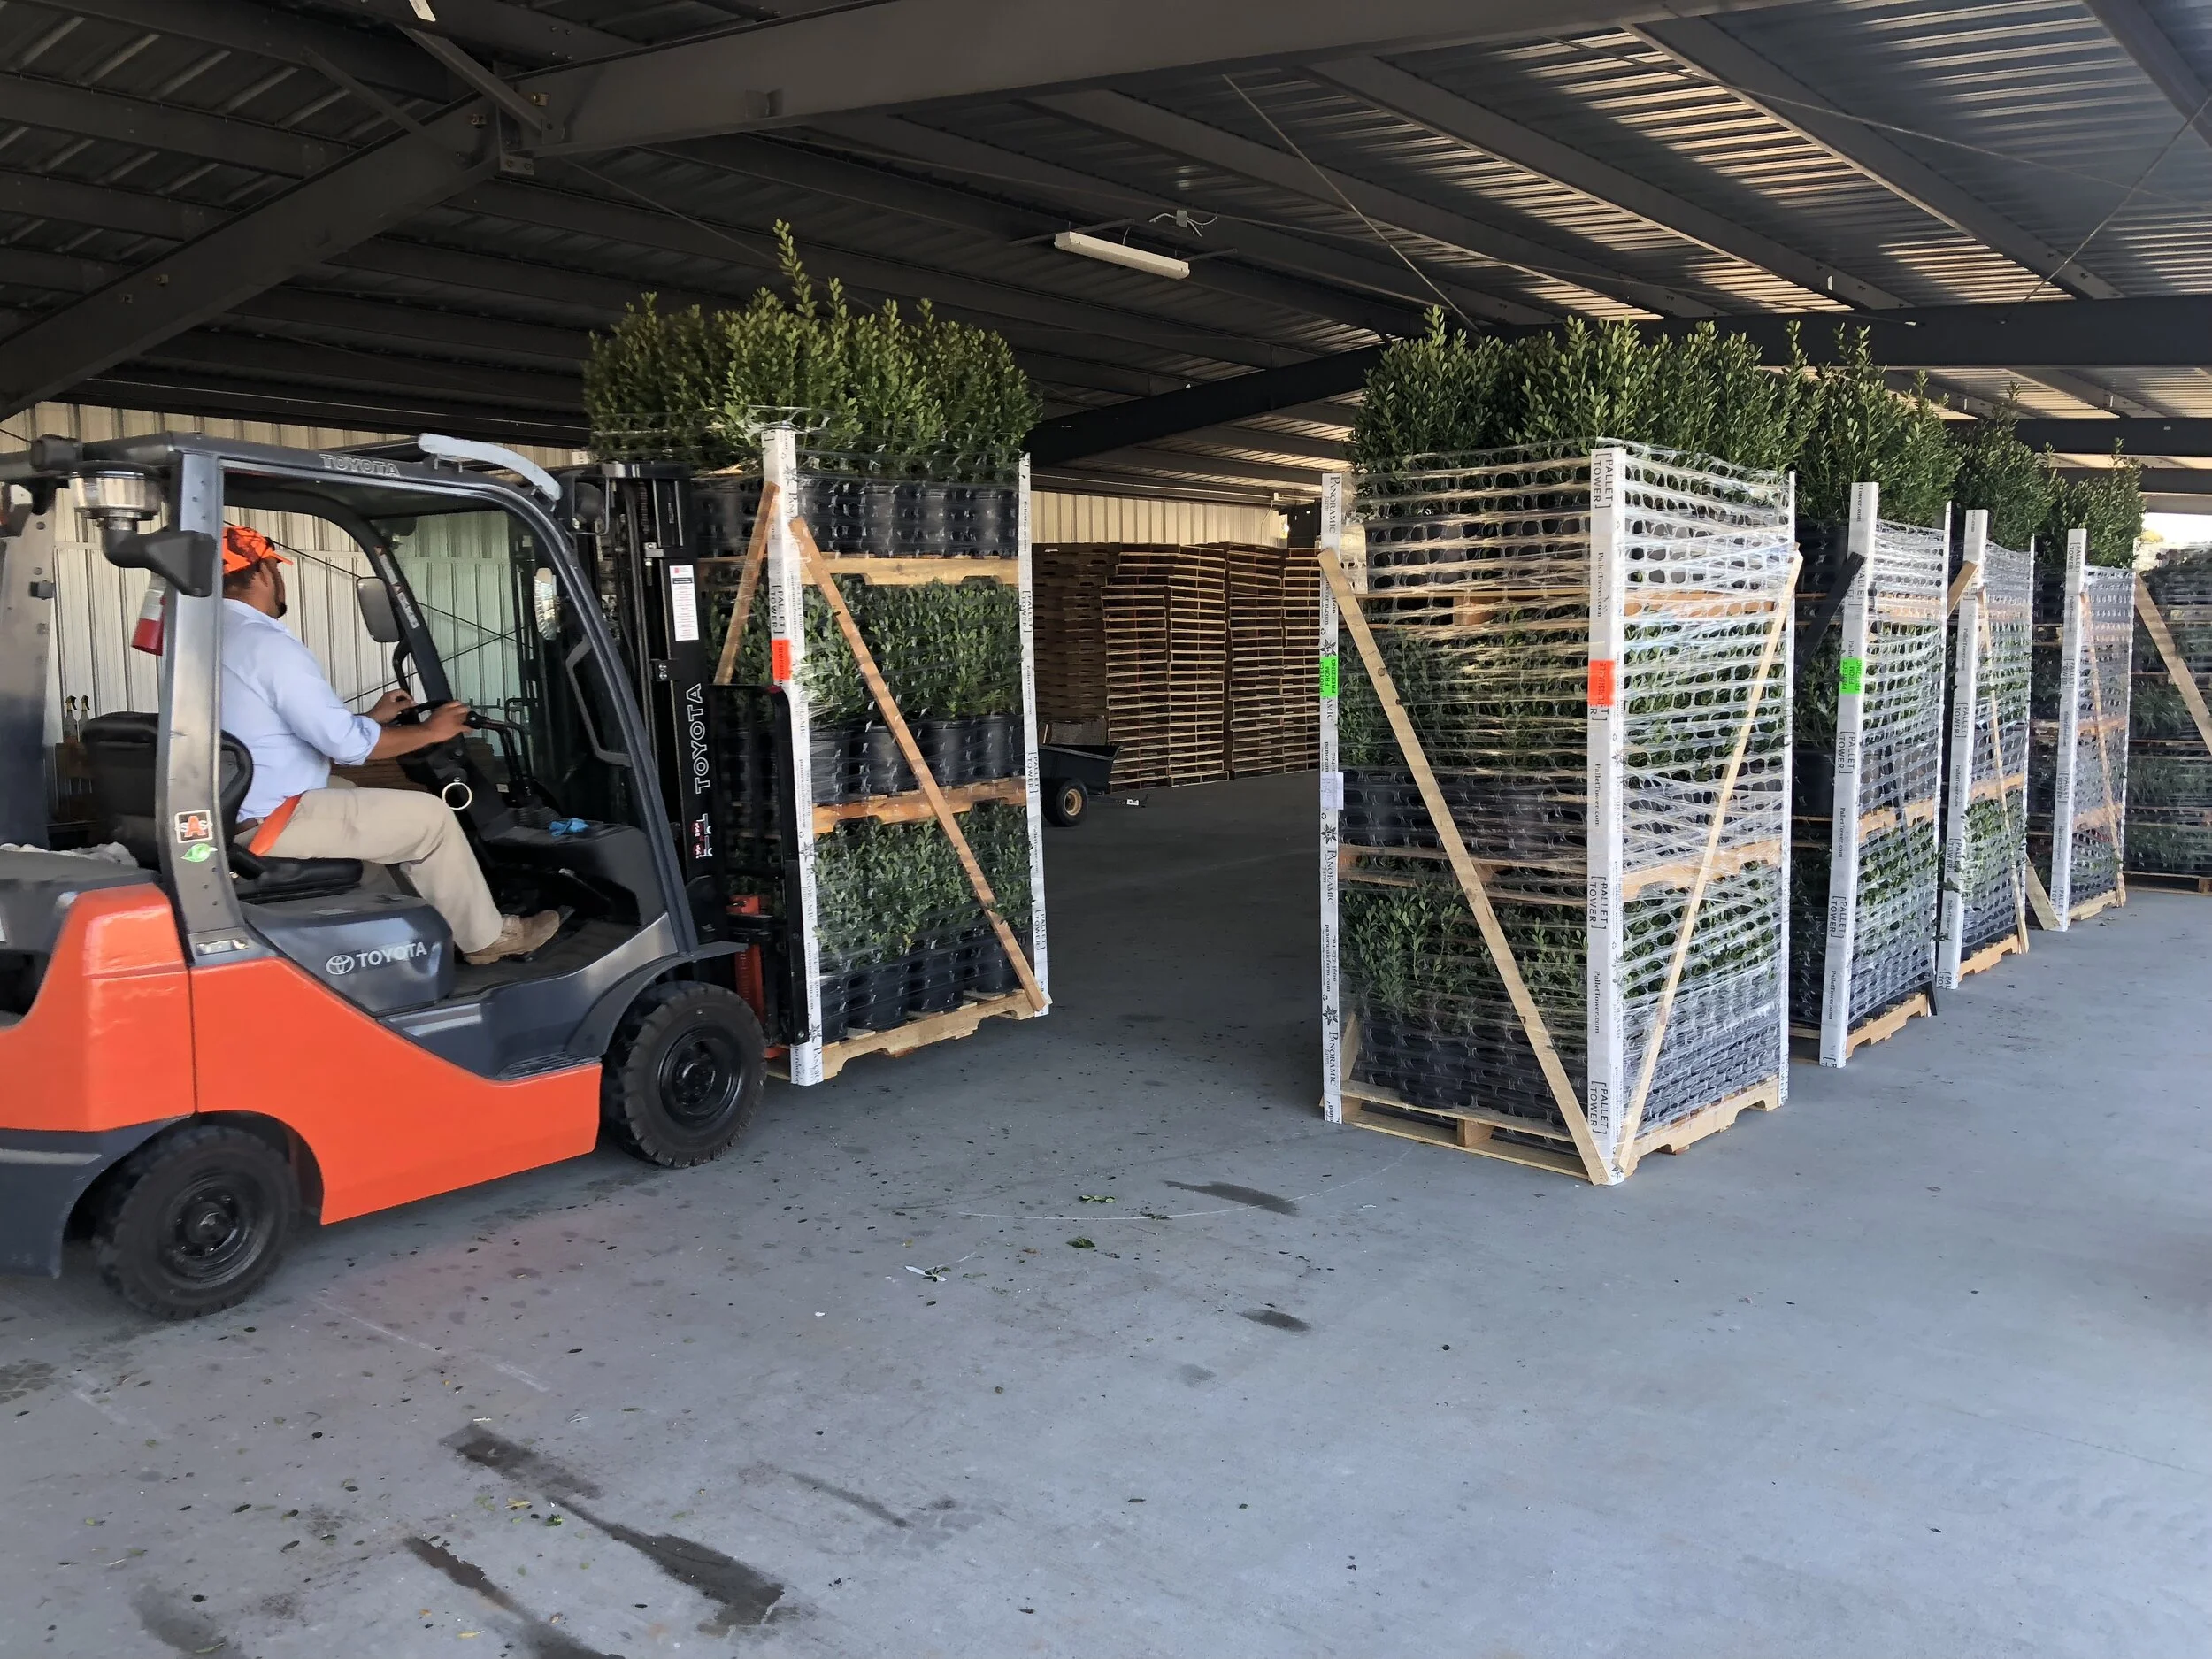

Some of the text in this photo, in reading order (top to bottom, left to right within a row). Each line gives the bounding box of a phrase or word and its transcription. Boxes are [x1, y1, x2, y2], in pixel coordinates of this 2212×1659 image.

[319, 453, 401, 478] TOYOTA
[1605, 459, 1614, 502] PALLET
[1329, 475, 1341, 534] PANORAMIC
[686, 683, 711, 795] TOYOTA
[1327, 849, 1337, 904] PANORAMIC
[1839, 902, 1847, 933] PALLET
[356, 941, 427, 968] TOYOTA
[1828, 970, 1837, 1019] PalletTower.com
[1329, 1031, 1339, 1086] PANORAMIC
